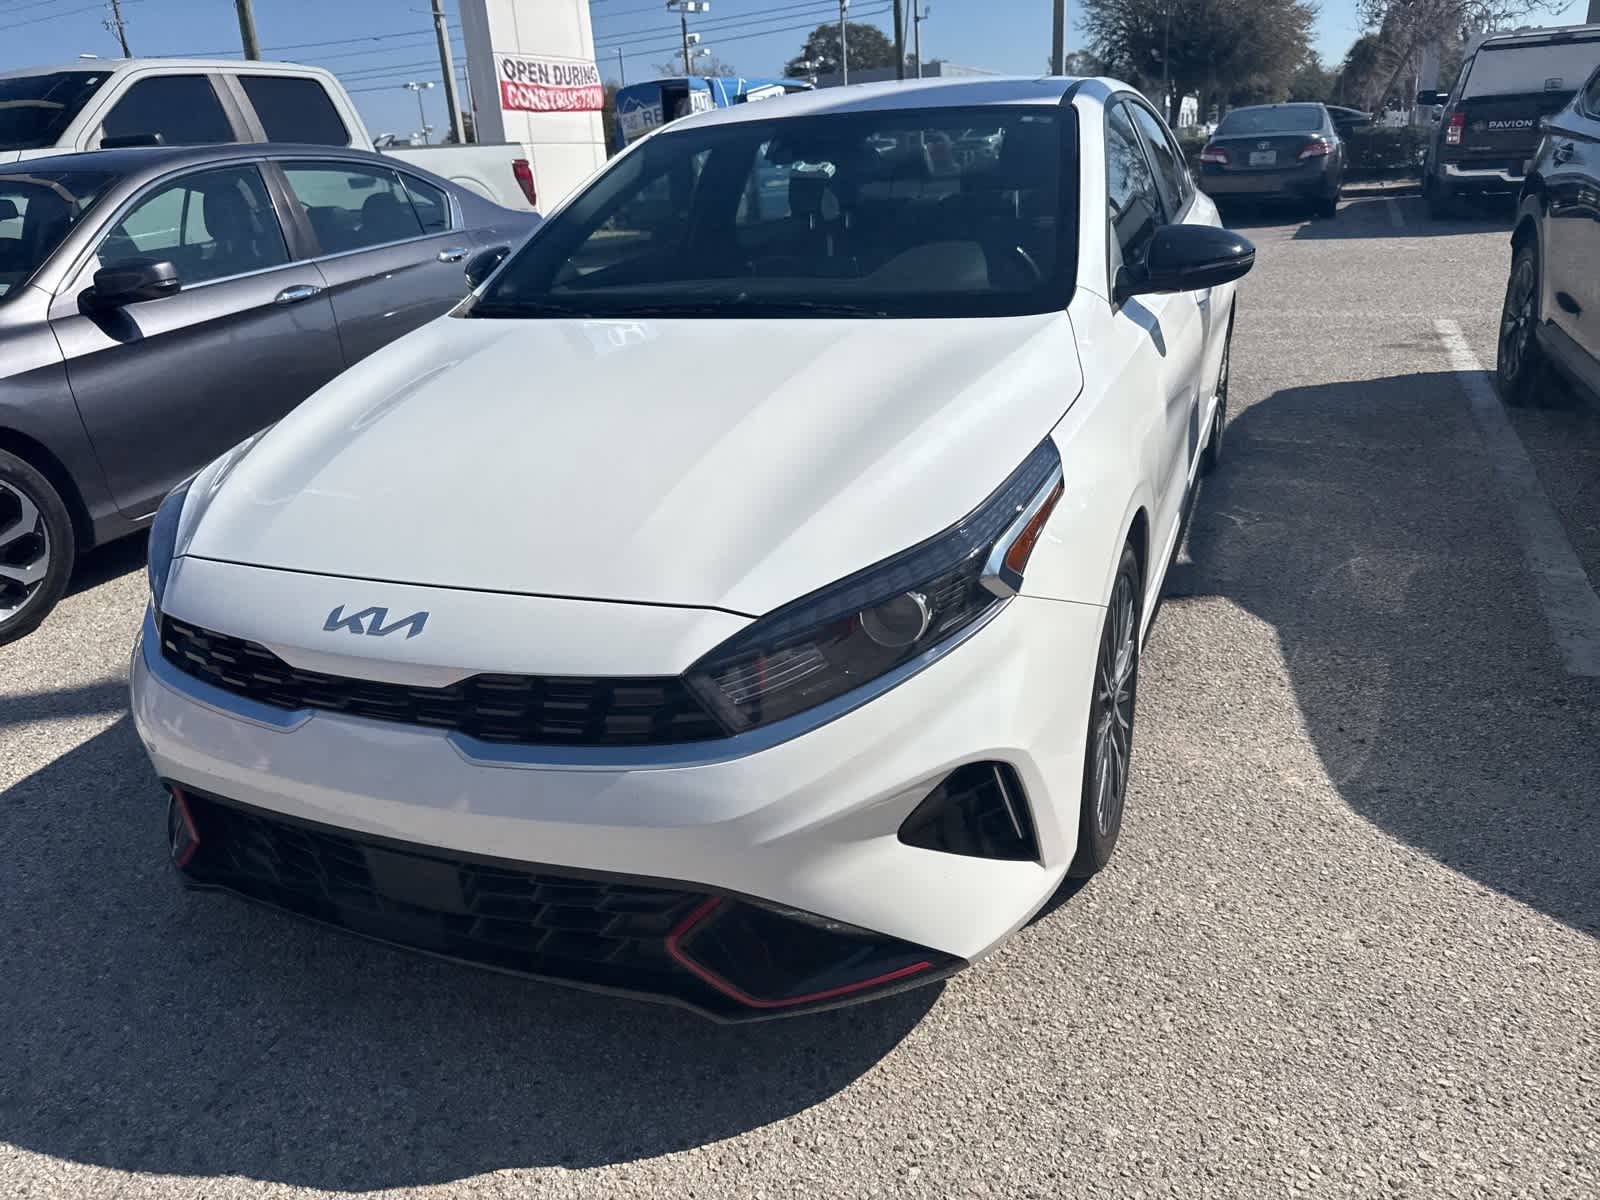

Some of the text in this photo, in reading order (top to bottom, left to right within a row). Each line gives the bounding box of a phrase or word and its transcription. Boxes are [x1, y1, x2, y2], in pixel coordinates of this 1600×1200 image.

[503, 59, 598, 85] OPEN DURING
[507, 85, 601, 110] CONSTRUCTION
[1488, 120, 1533, 128] PAVION
[323, 604, 429, 639] KIA
